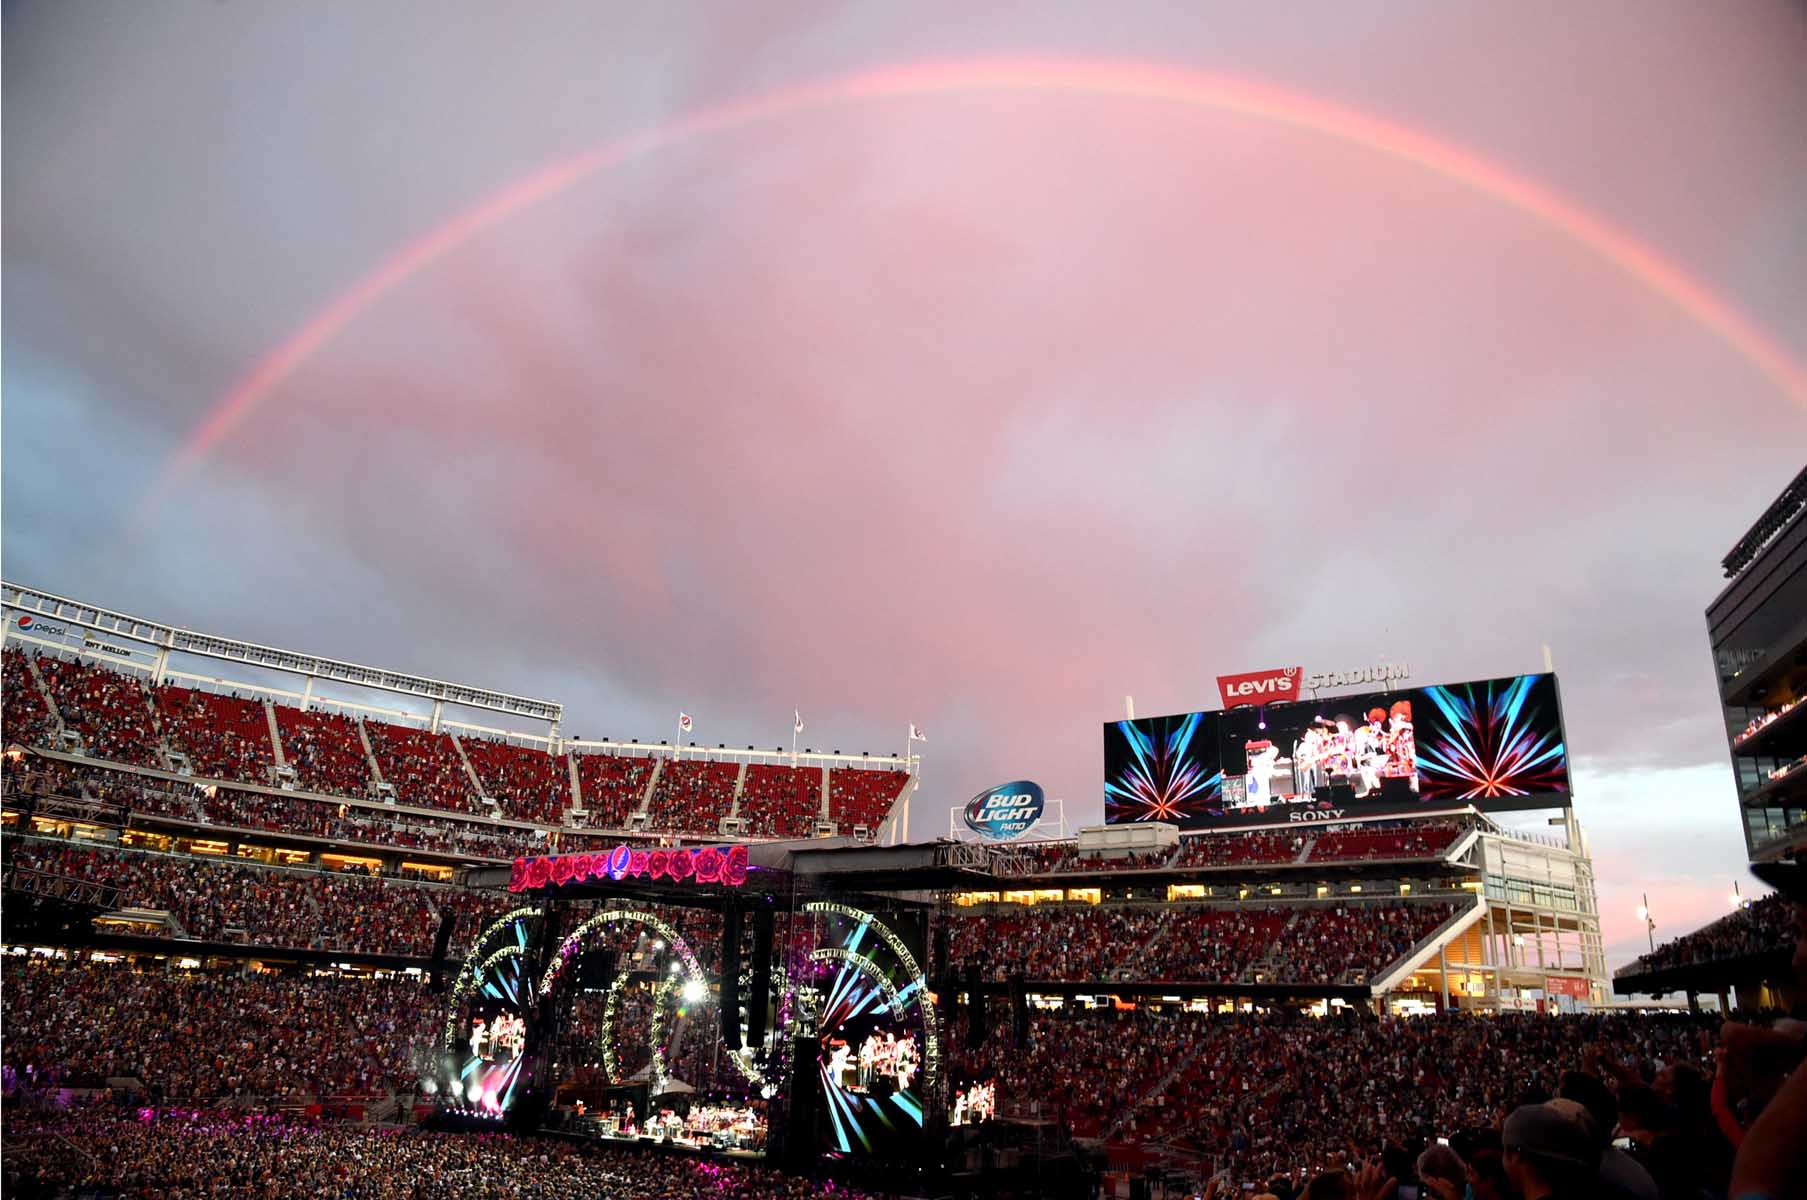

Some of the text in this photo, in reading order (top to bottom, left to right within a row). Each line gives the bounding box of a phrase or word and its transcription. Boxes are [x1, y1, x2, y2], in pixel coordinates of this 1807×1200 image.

[34, 623, 65, 636] pepsi
[101, 644, 131, 656] MELLON
[1309, 663, 1410, 689] STADIUM
[1289, 809, 1345, 822] SONY
